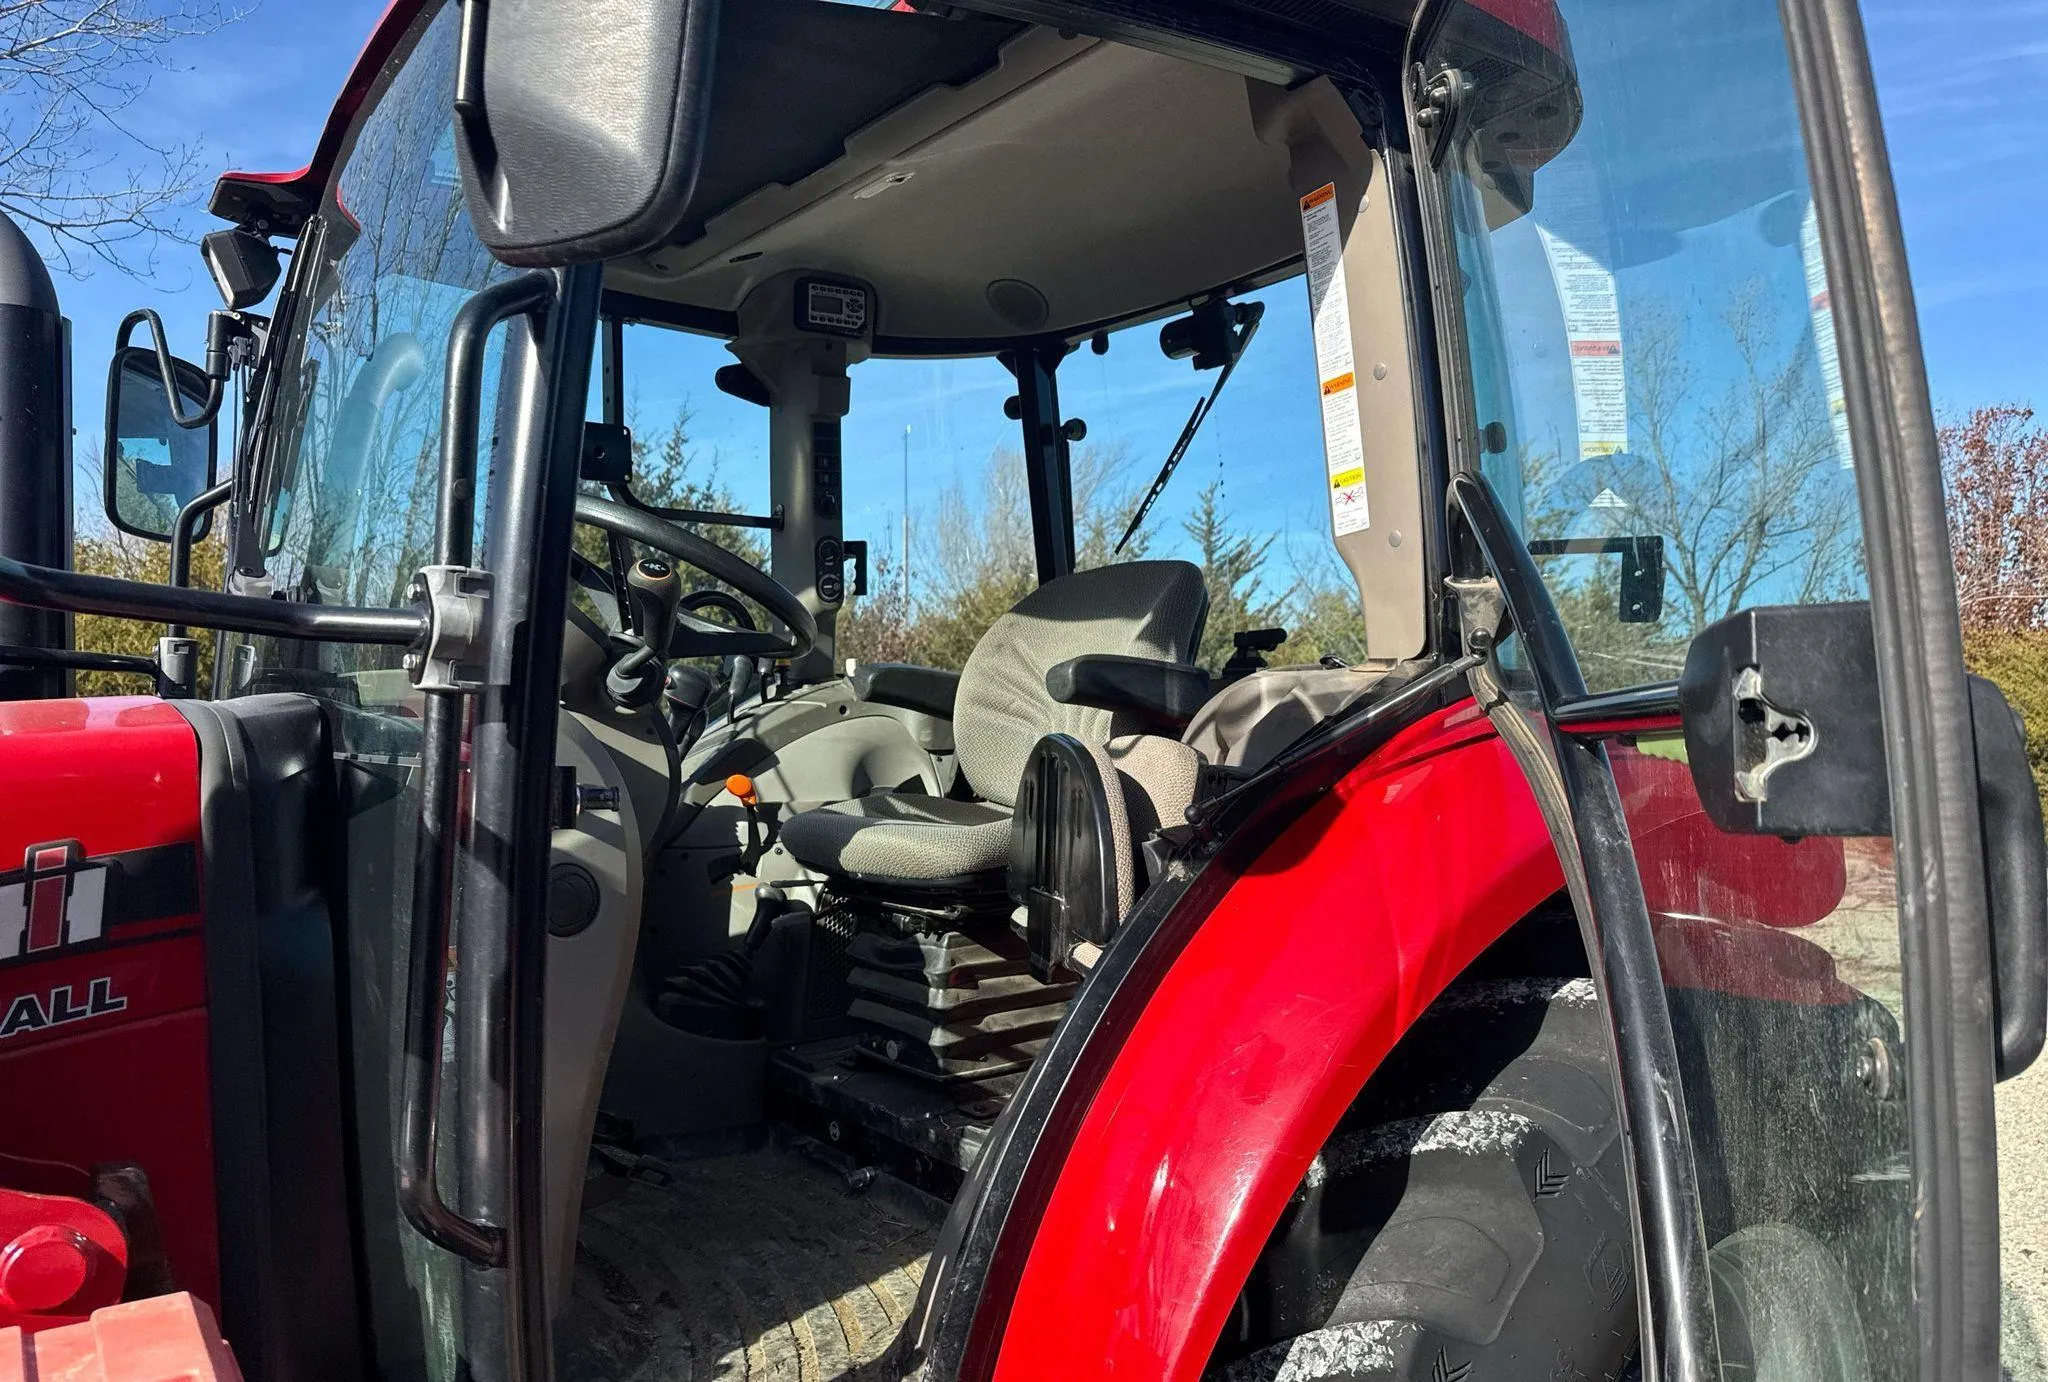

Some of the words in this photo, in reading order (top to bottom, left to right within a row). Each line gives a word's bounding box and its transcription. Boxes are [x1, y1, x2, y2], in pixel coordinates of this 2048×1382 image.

[1309, 188, 1333, 204] WARNING
[1330, 376, 1354, 389] WARNING
[1339, 473, 1362, 484] CAUTION
[0, 976, 128, 1038] ALL
